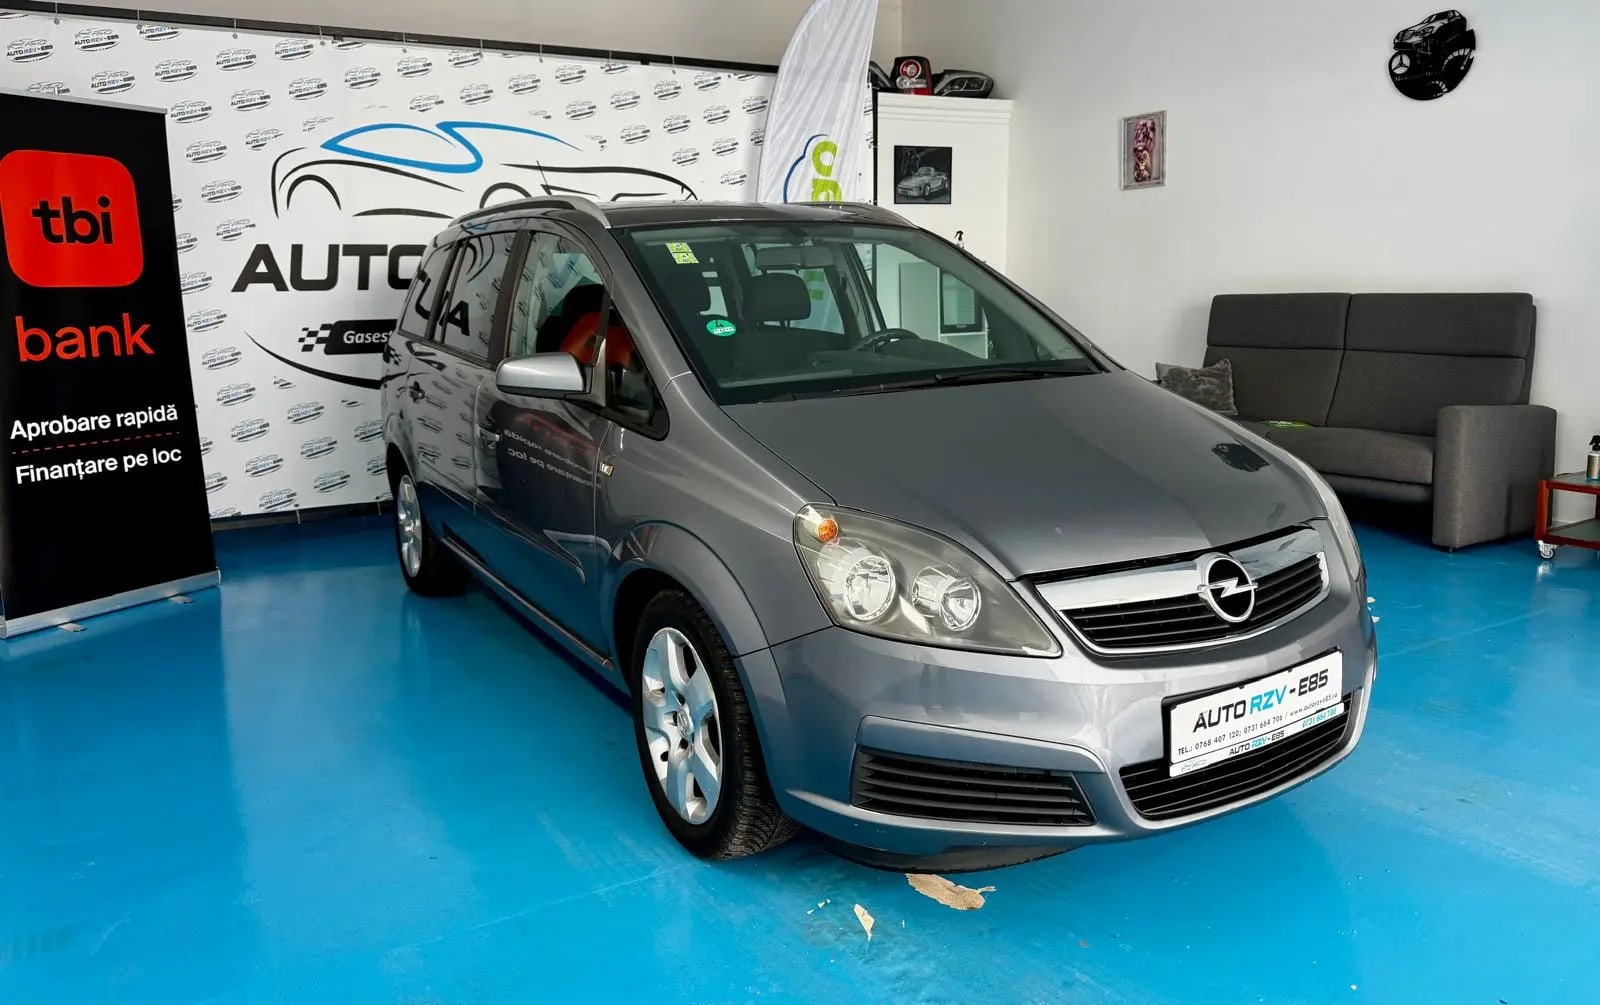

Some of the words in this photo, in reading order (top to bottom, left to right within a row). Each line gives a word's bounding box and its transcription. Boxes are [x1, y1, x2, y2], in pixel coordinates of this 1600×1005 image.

[32, 196, 113, 245] tbi
[231, 244, 427, 293] AUTO
[15, 312, 154, 362] bank
[10, 413, 112, 440] Aprobare
[116, 404, 178, 429] rapidă
[15, 456, 118, 484] Finanțare
[123, 452, 149, 473] pe
[152, 447, 182, 464] loc
[1193, 700, 1246, 733] AUTO
[1250, 685, 1287, 714] RZV
[1298, 669, 1329, 697] E85
[1195, 739, 1212, 751] 0768
[1214, 734, 1226, 744] 407
[1244, 723, 1258, 735] 0731
[1273, 714, 1283, 724] 706
[1229, 742, 1250, 756] AUTO
[1251, 736, 1268, 749] RZV
